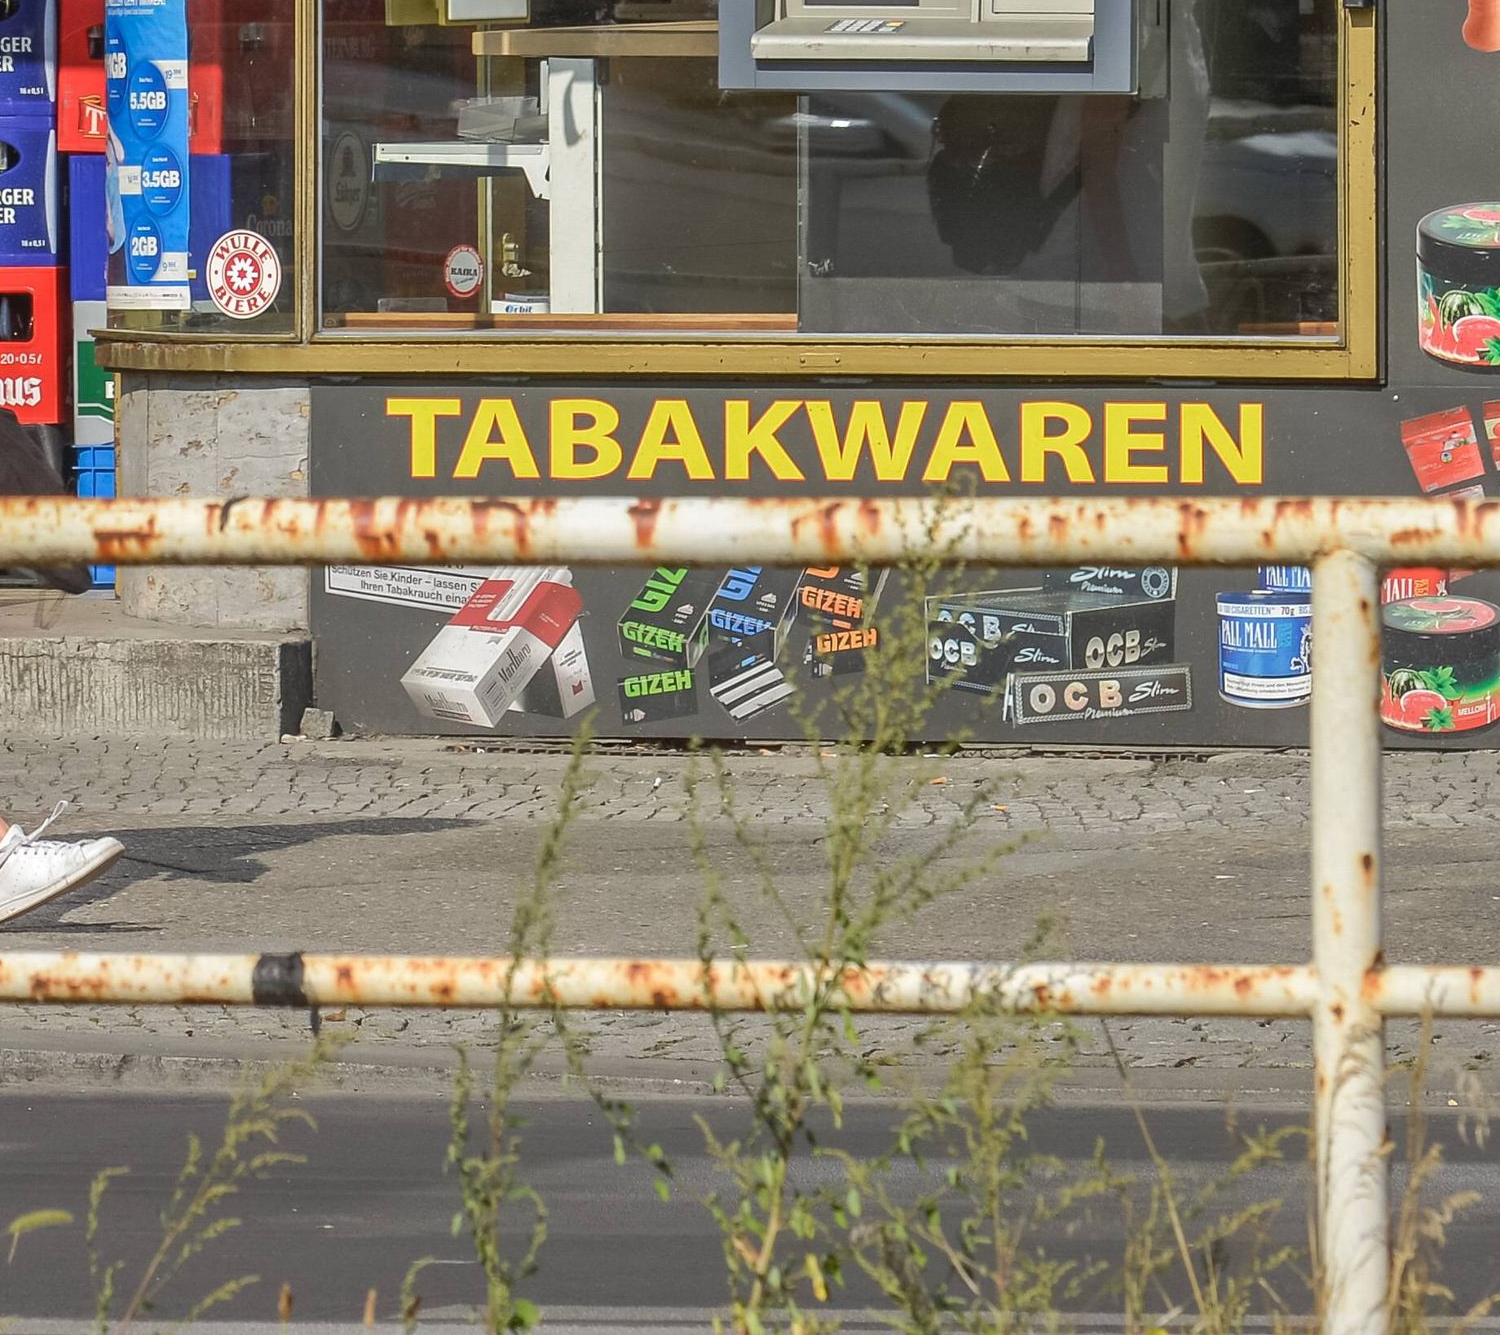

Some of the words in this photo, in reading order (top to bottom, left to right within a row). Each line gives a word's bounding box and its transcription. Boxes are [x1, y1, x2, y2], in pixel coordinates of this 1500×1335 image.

[130, 91, 167, 111] 5.5GB
[142, 170, 181, 189] 3.5GB
[131, 235, 158, 257] 2GB
[214, 234, 274, 265] WULLE
[213, 284, 274, 315] BIERE
[385, 397, 1264, 485] TABAKWAREN
[623, 669, 693, 698] GIZEH
